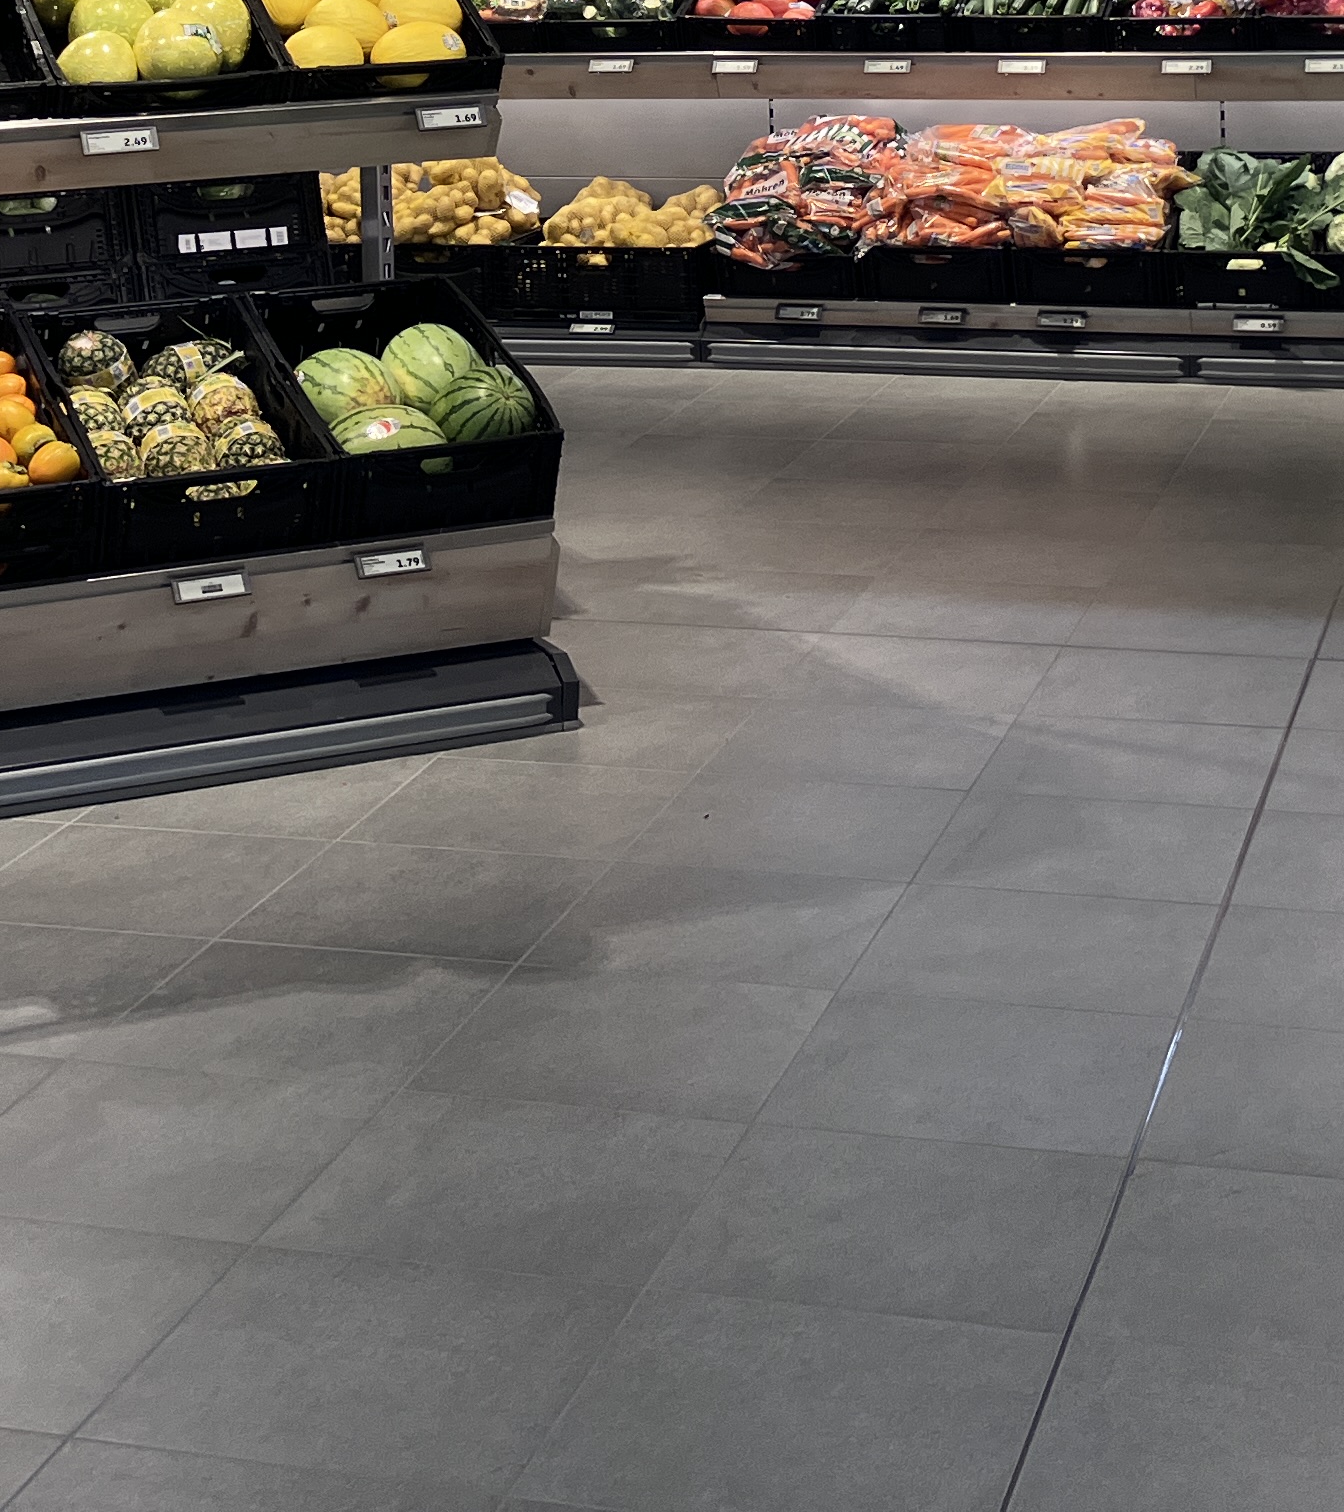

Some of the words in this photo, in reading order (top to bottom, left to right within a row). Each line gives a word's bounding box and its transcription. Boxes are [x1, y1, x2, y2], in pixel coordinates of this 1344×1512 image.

[455, 112, 477, 124] 1.69
[123, 137, 148, 148] 2.49
[397, 557, 420, 569] 1.79
